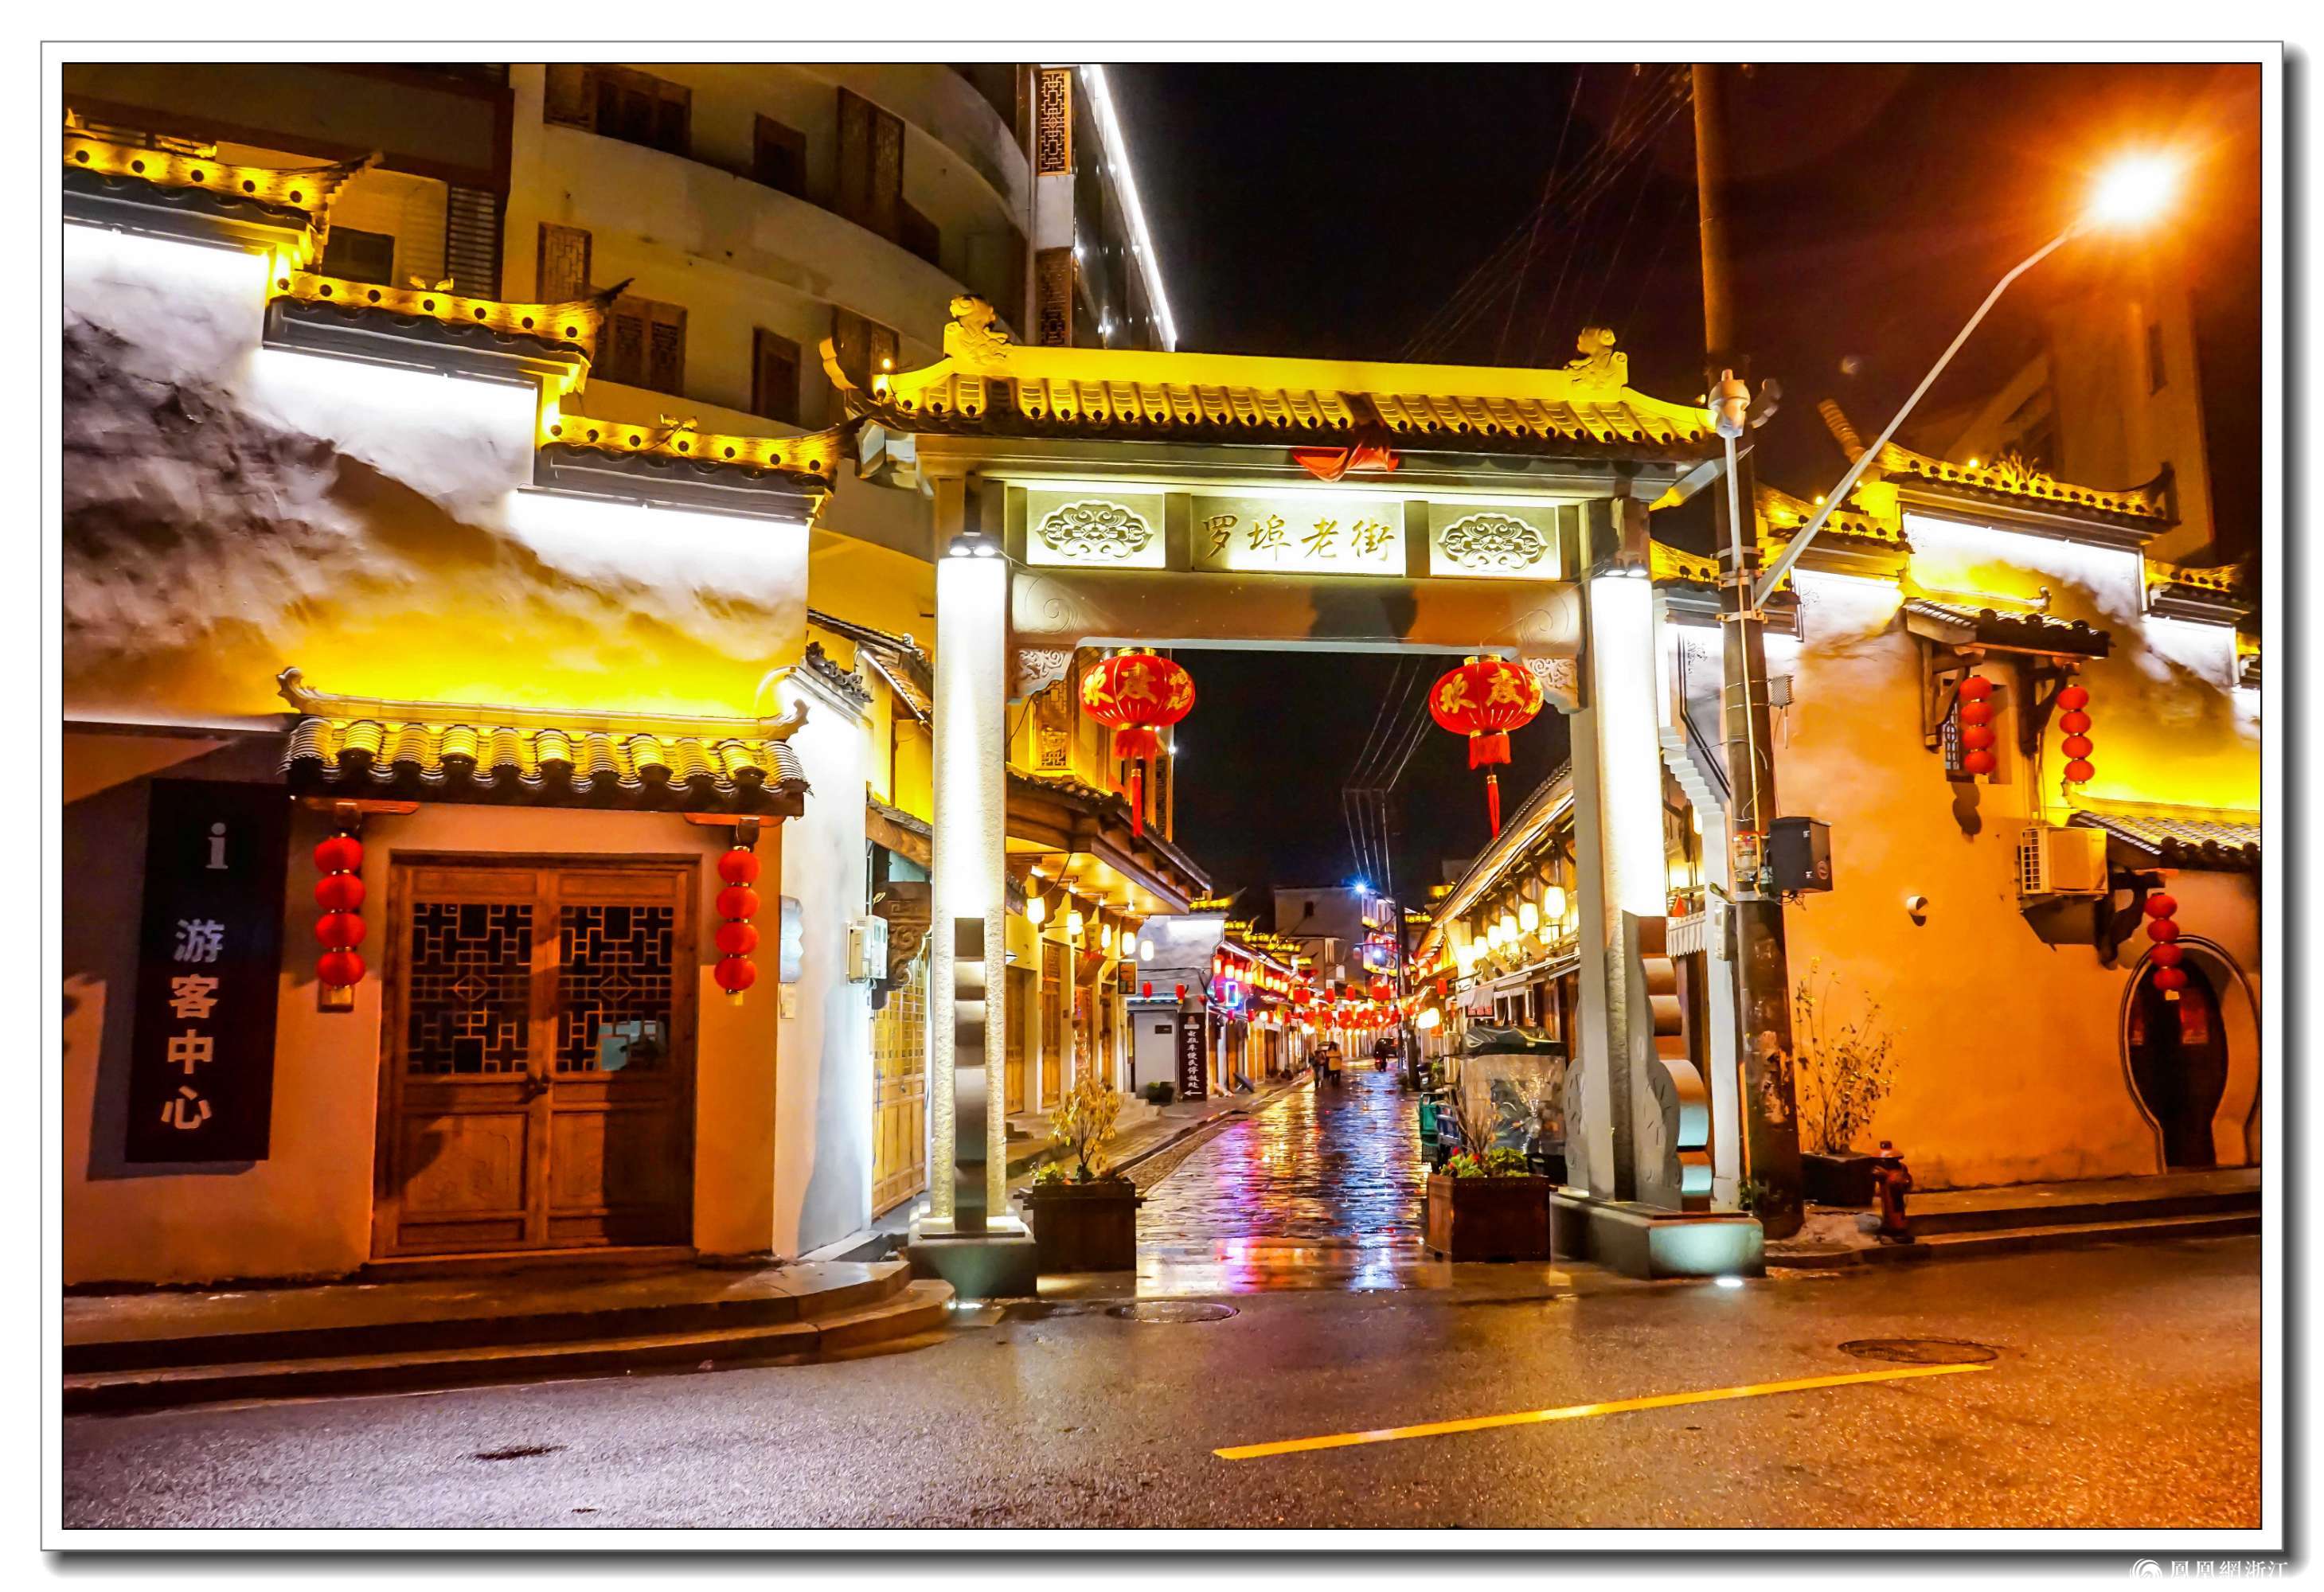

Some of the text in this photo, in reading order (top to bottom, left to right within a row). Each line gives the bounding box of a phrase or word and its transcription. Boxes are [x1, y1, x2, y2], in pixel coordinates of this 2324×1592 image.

[1203, 514, 1395, 561] 罗埠老街
[161, 919, 225, 1130] 游客中心
